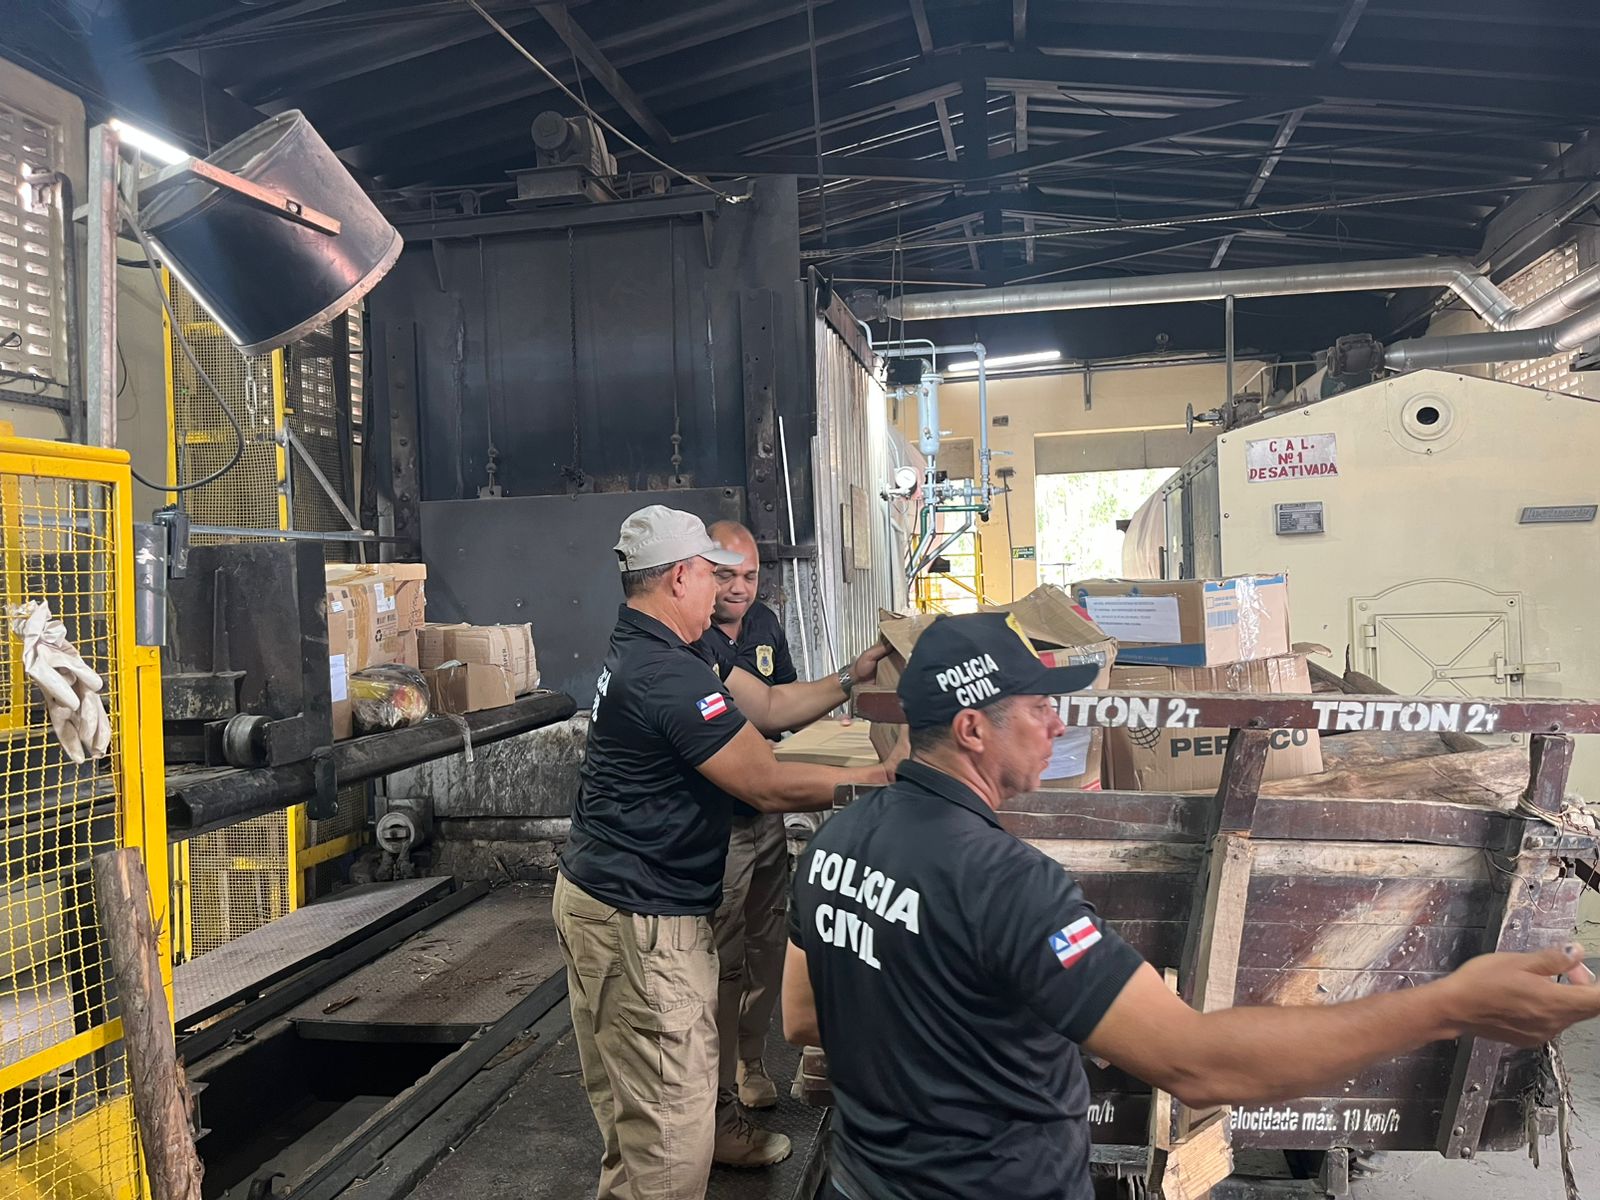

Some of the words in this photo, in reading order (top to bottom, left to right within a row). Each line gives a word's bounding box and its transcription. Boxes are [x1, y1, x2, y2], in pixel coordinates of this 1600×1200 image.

[1249, 462, 1338, 480] DESATIVADA
[1297, 452, 1303, 463] 1
[955, 677, 1001, 707] CIVIL
[1049, 696, 1159, 728] ITON
[1312, 701, 1461, 732] TRITON
[1170, 729, 1309, 758] PEPCO
[815, 903, 881, 971] CIVIL
[1087, 1100, 1115, 1126] m/h
[1230, 1106, 1300, 1132] elocidade
[1343, 1108, 1362, 1132] 10
[1363, 1108, 1401, 1135] km/h
